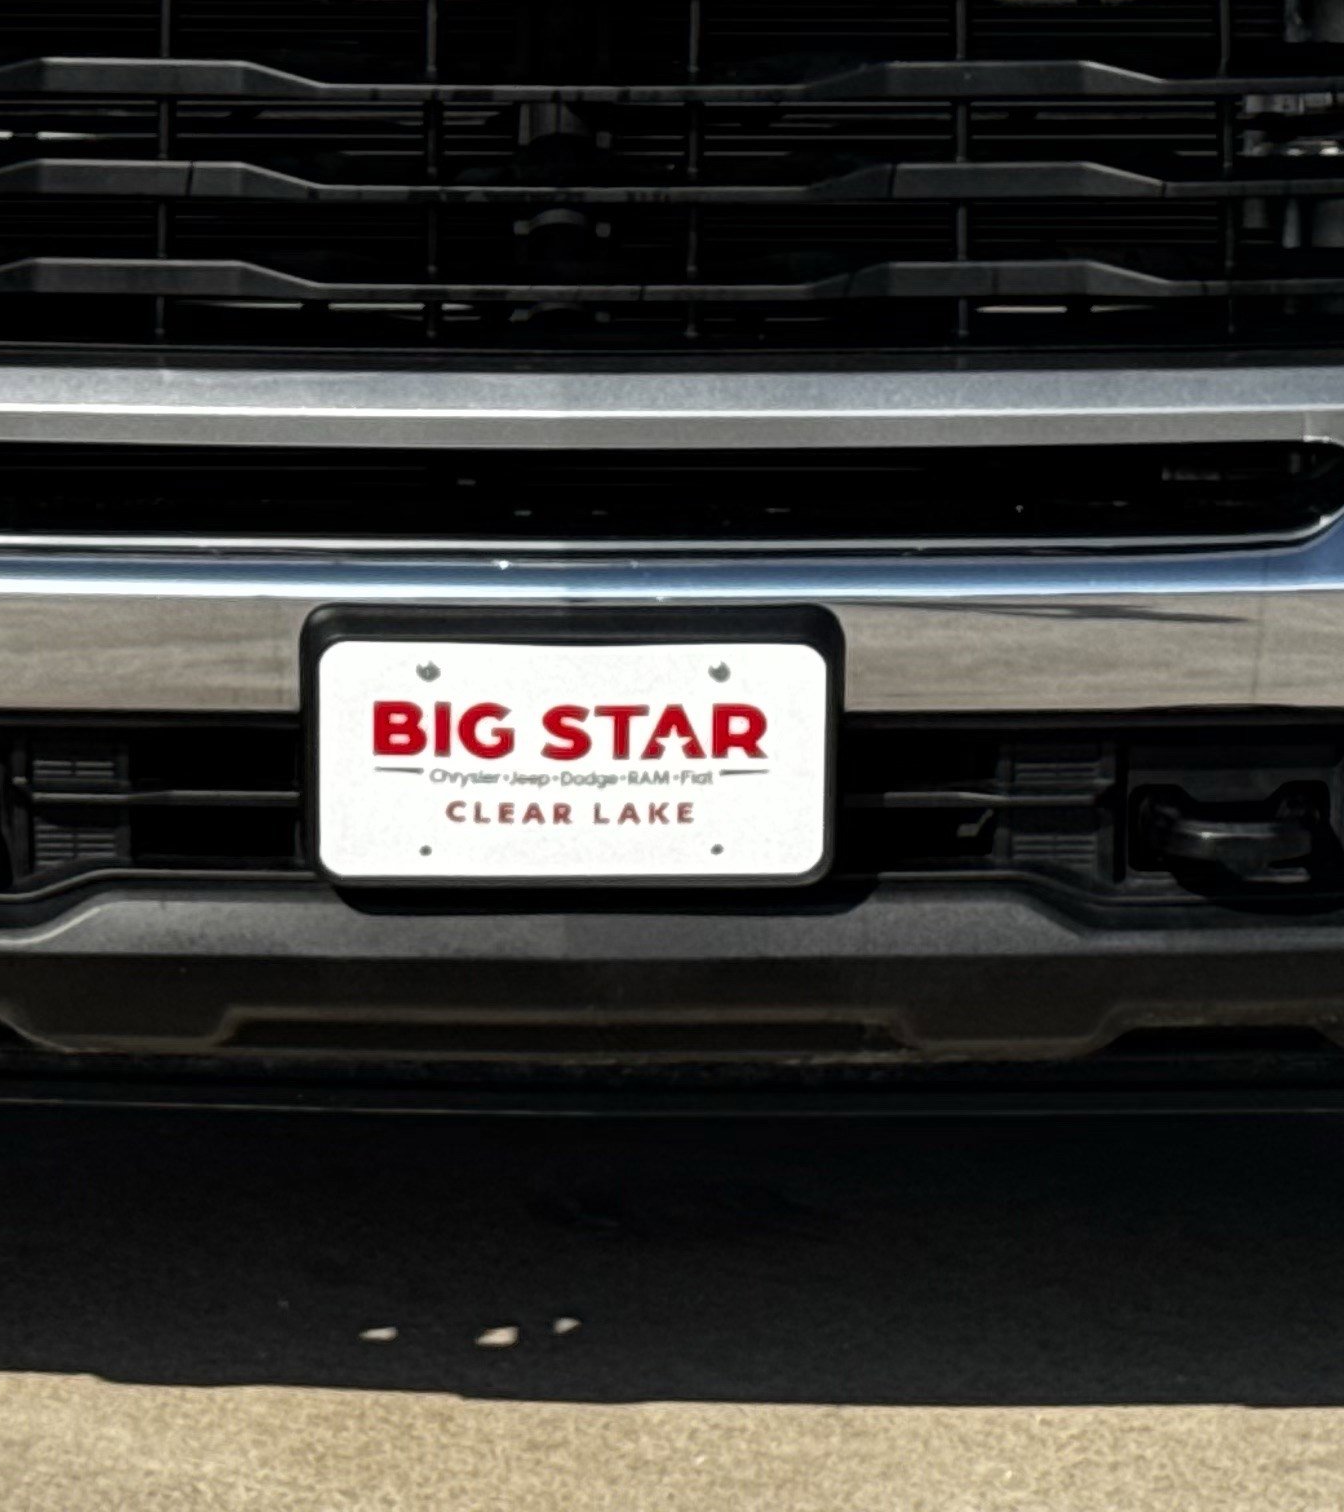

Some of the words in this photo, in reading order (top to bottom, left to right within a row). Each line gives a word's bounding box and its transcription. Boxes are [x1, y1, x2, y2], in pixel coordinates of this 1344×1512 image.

[373, 700, 515, 760] BIG
[540, 703, 767, 761] STAR
[561, 771, 618, 788] Dodge
[628, 770, 670, 784] RAM
[680, 770, 713, 785] Fiat
[446, 801, 572, 825] CLEAR
[594, 802, 694, 825] LAKE
